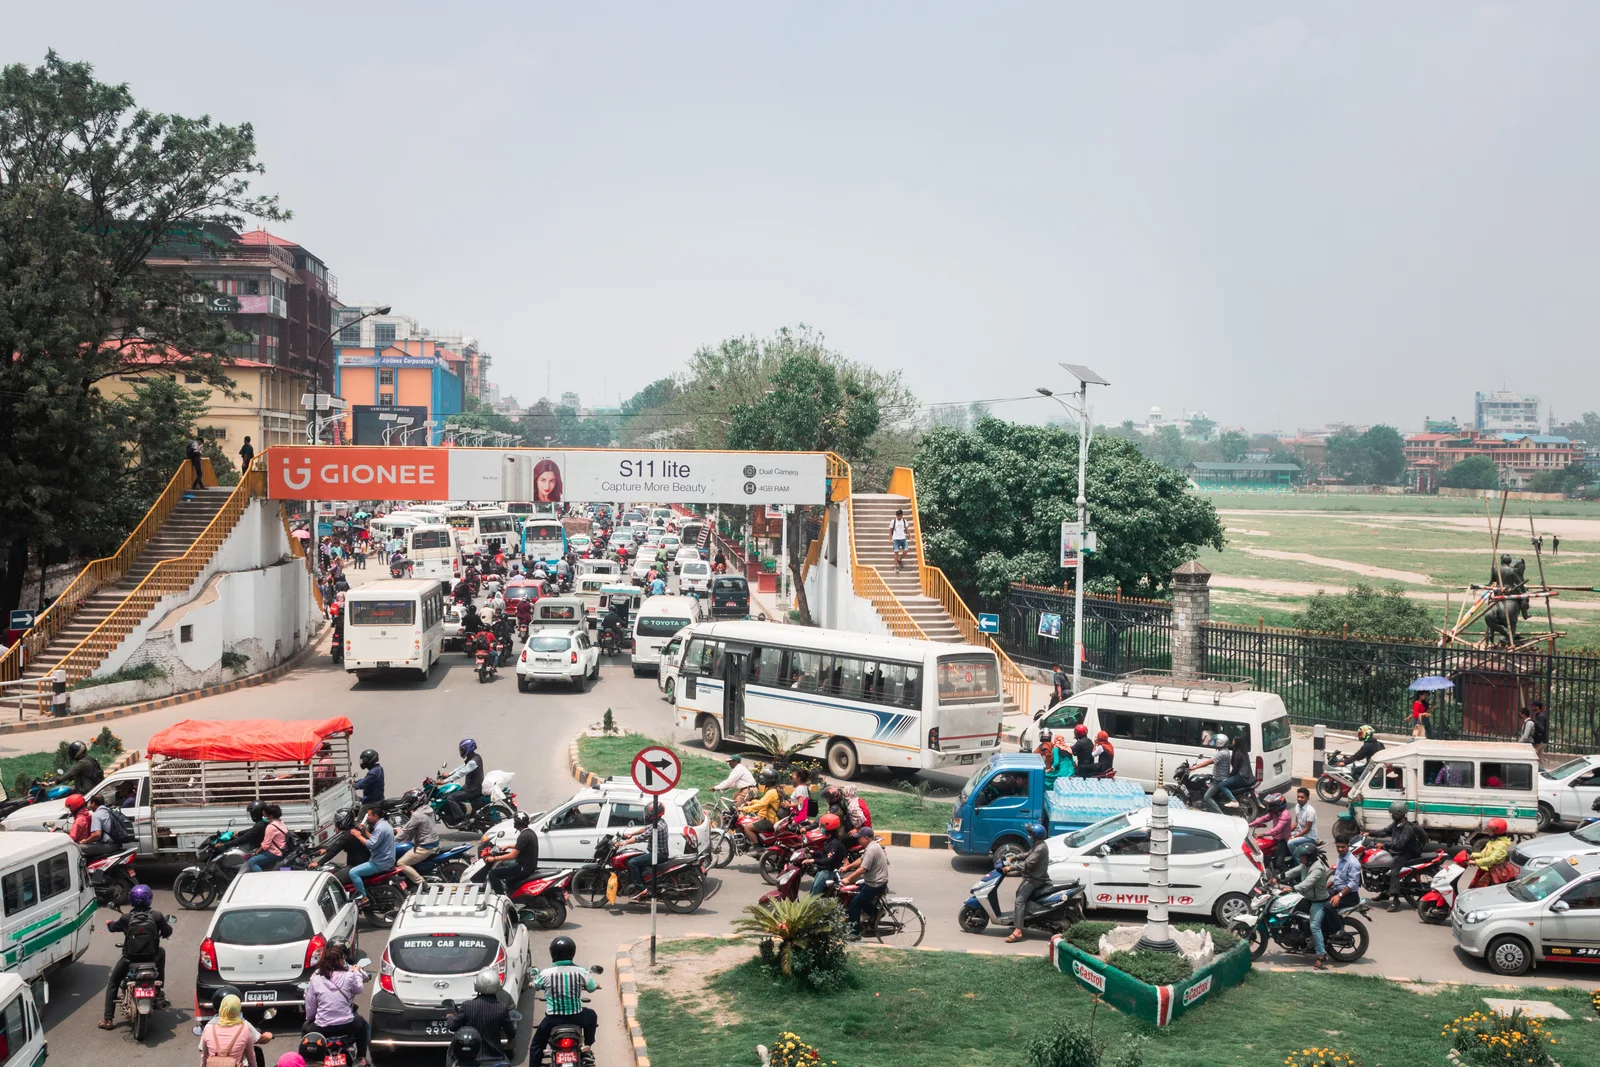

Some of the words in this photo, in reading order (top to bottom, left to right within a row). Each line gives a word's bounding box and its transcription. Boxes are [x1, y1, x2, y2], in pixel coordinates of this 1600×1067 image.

[320, 464, 435, 484] GIONEE
[619, 460, 654, 478] S11
[662, 460, 691, 478] lite
[774, 468, 799, 476] Camera
[601, 481, 641, 493] Capture
[644, 482, 670, 492] More
[672, 483, 706, 494] Beauty
[1116, 893, 1175, 905] HYUI
[404, 940, 433, 948] METRO
[437, 940, 455, 948] CAB
[459, 940, 486, 948] NEPAL
[1079, 966, 1103, 989] Castrol
[1188, 980, 1208, 1000] Castrol
